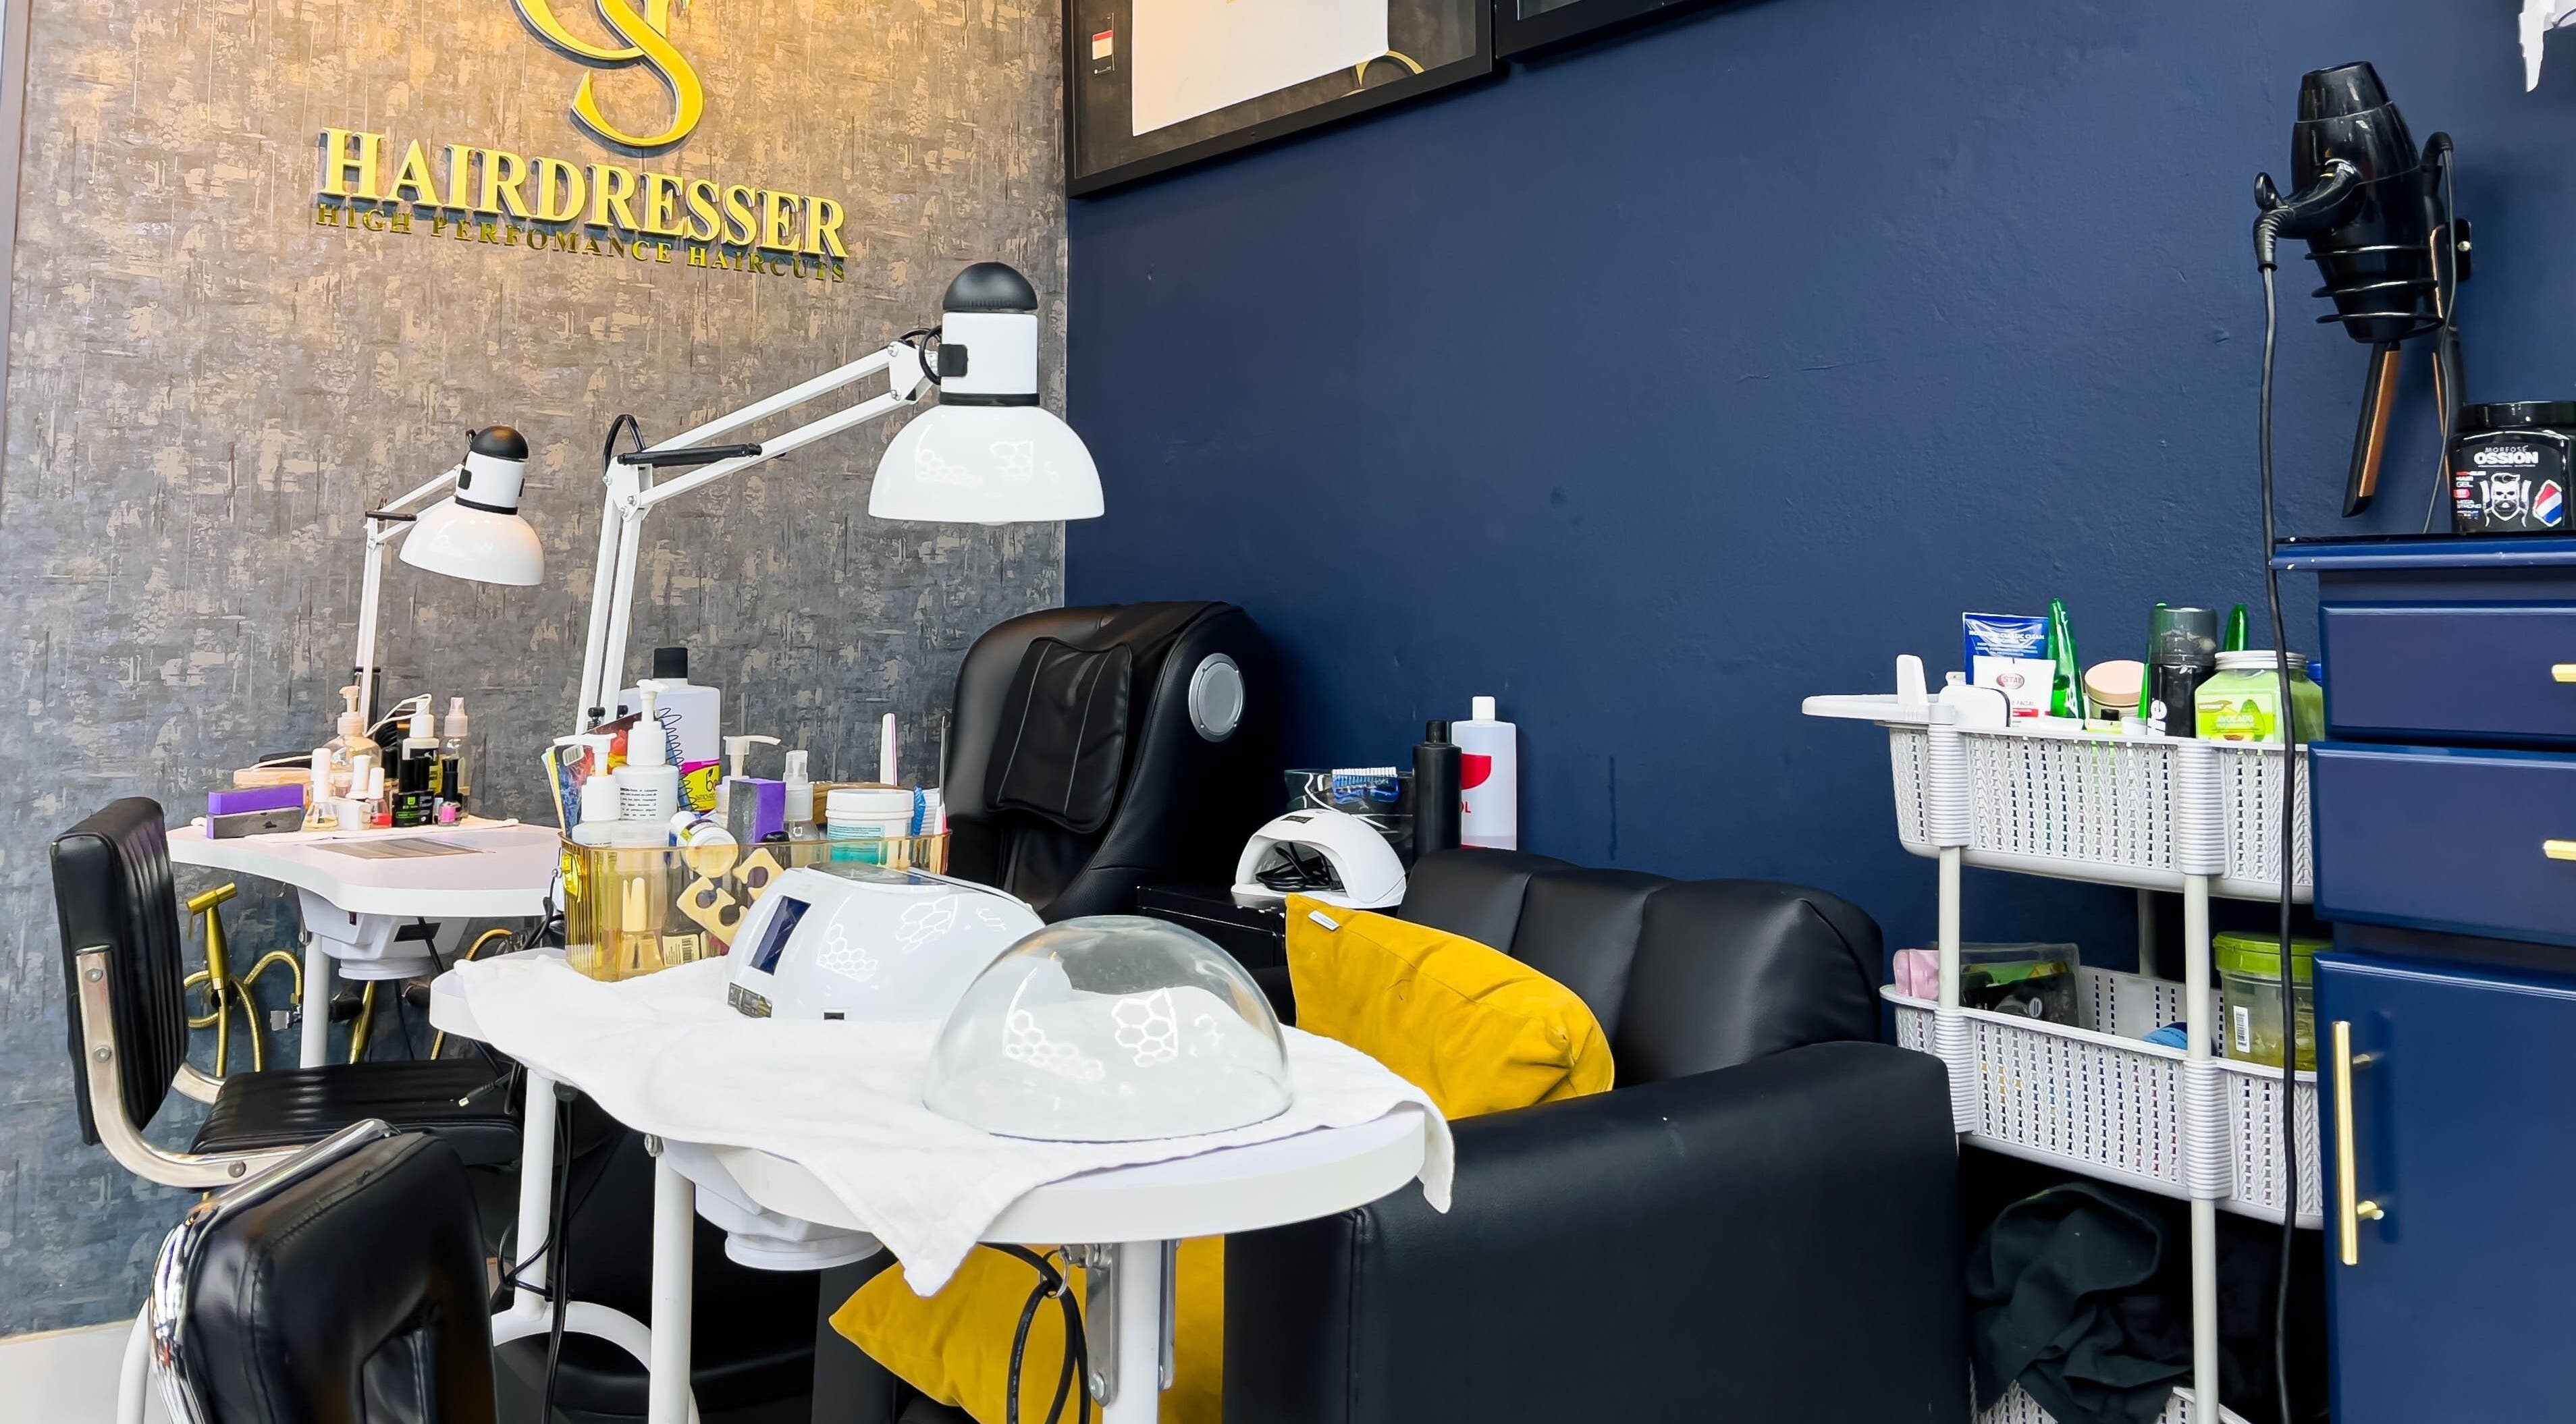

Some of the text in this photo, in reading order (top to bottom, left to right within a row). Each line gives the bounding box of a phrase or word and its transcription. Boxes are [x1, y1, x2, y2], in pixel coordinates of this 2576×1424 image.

[319, 126, 849, 258] HAIRDRESSER
[316, 203, 846, 284] HIGH PERFOMANCE HAIRCUTS
[2473, 451, 2539, 465] OSSION
